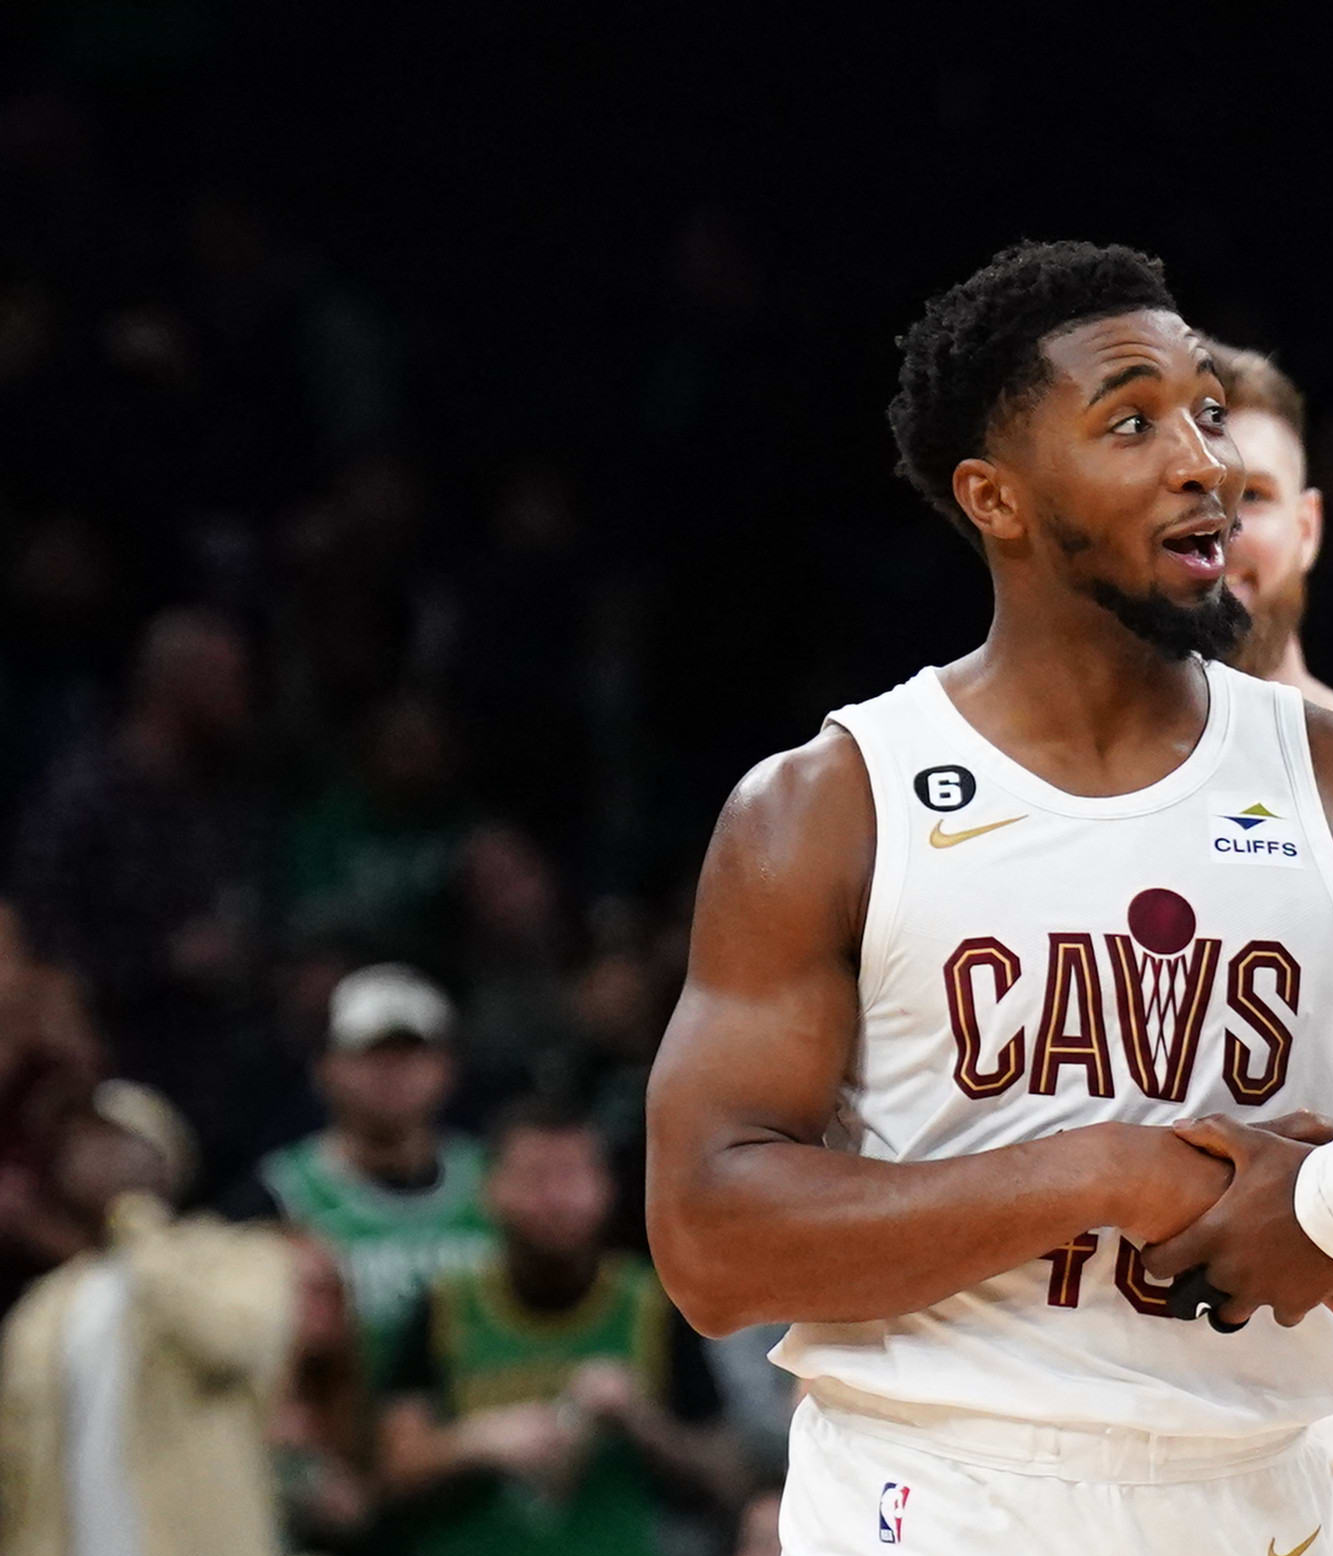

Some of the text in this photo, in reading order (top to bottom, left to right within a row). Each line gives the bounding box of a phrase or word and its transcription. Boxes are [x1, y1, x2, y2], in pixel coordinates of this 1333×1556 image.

[927, 771, 963, 806] 6
[1214, 837, 1298, 857] CLIFFS
[943, 932, 1301, 1106] CAVS
